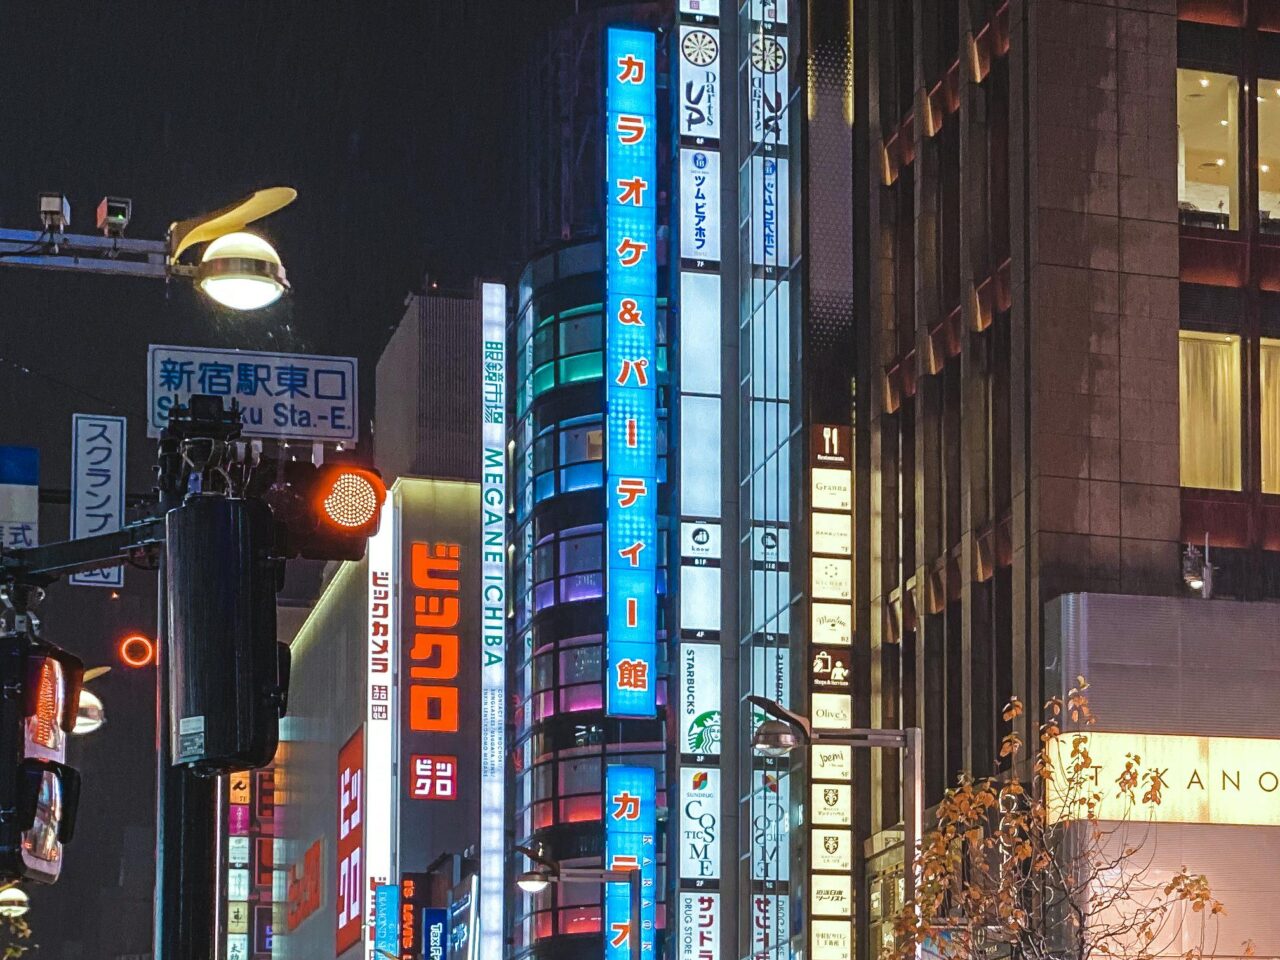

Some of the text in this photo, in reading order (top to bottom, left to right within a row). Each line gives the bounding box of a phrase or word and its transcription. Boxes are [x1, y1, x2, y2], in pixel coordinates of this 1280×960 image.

[706, 71, 717, 127] Darts
[159, 357, 347, 401] 新宿駅東口
[484, 448, 504, 668] MEGANE ICHIBA
[686, 649, 695, 715] STARBUCKS
[816, 708, 848, 719] Olive's
[1092, 765, 1280, 793] TKANO
[378, 891, 387, 938] DIAMOND
[430, 922, 442, 947] Tax
[684, 898, 693, 955] DRUG STORE
